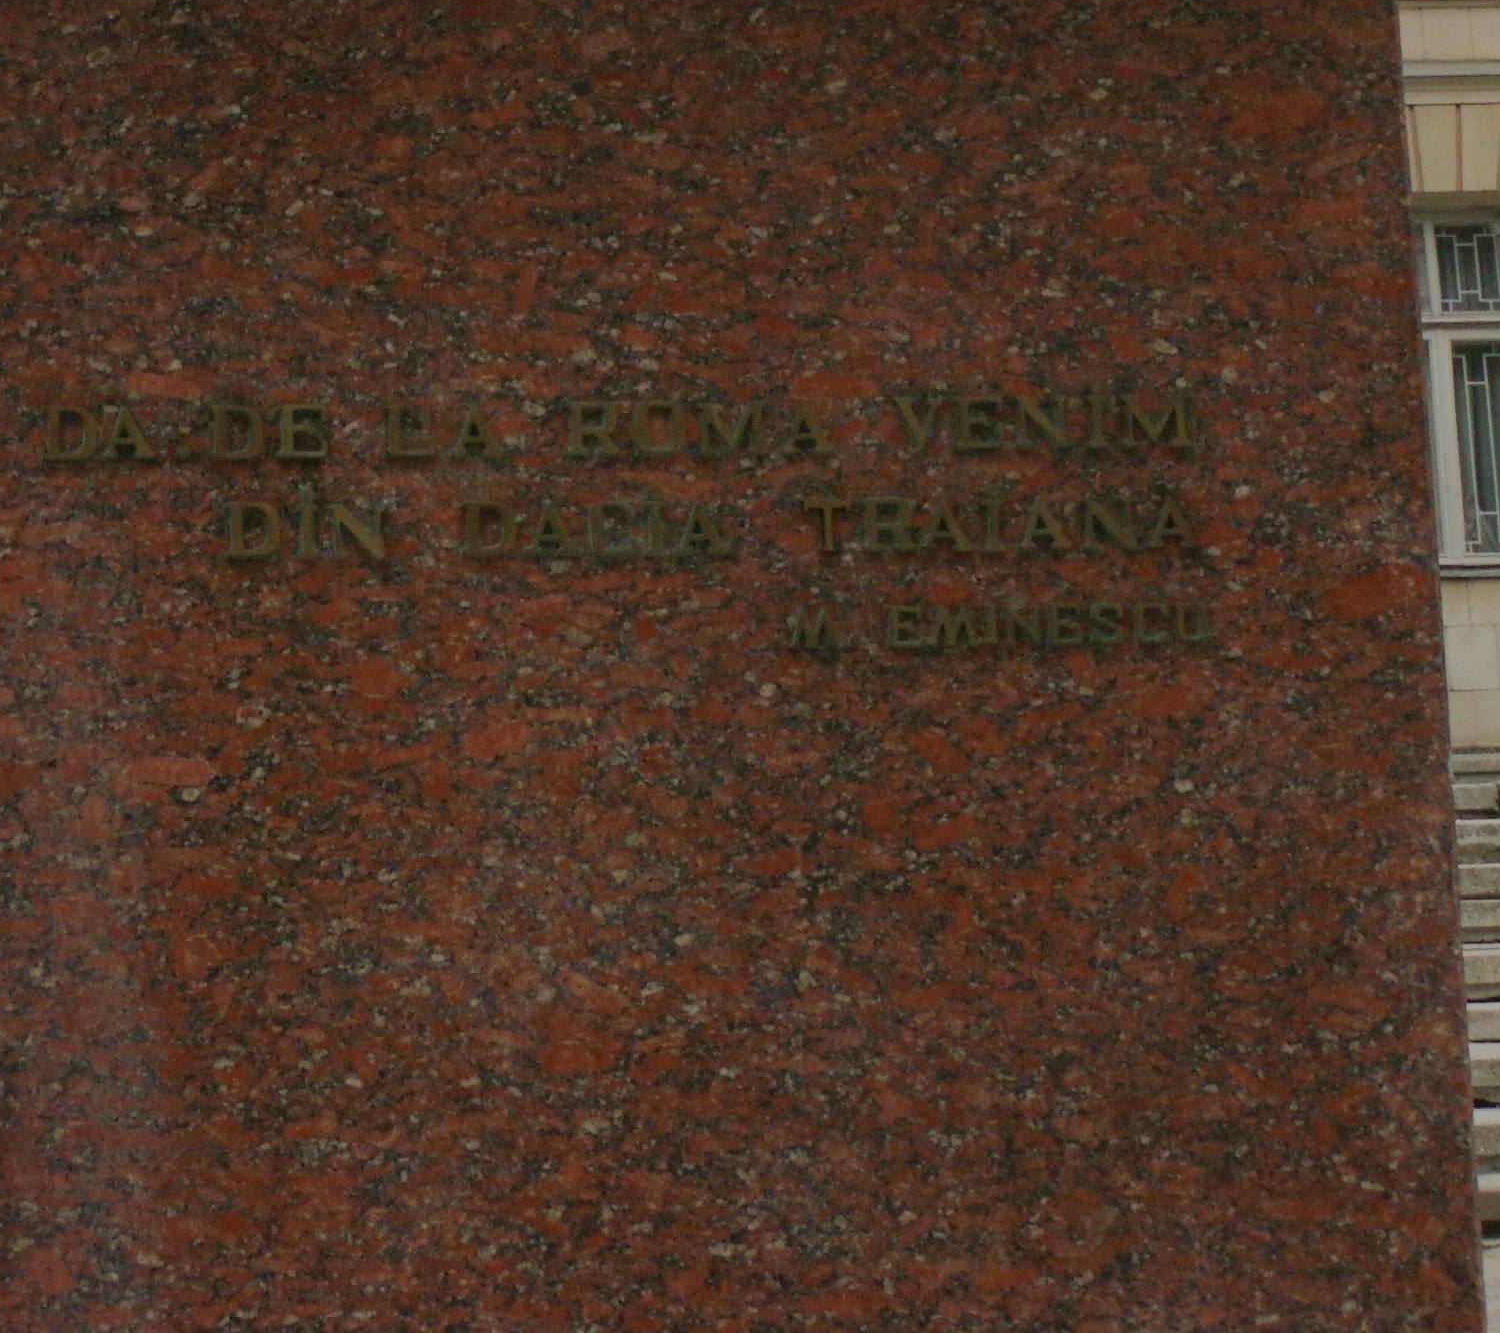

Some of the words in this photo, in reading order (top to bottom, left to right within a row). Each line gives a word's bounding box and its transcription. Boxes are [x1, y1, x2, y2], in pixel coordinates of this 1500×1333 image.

[211, 403, 330, 459] DE
[386, 400, 508, 458] LA
[562, 397, 838, 456] ROMA
